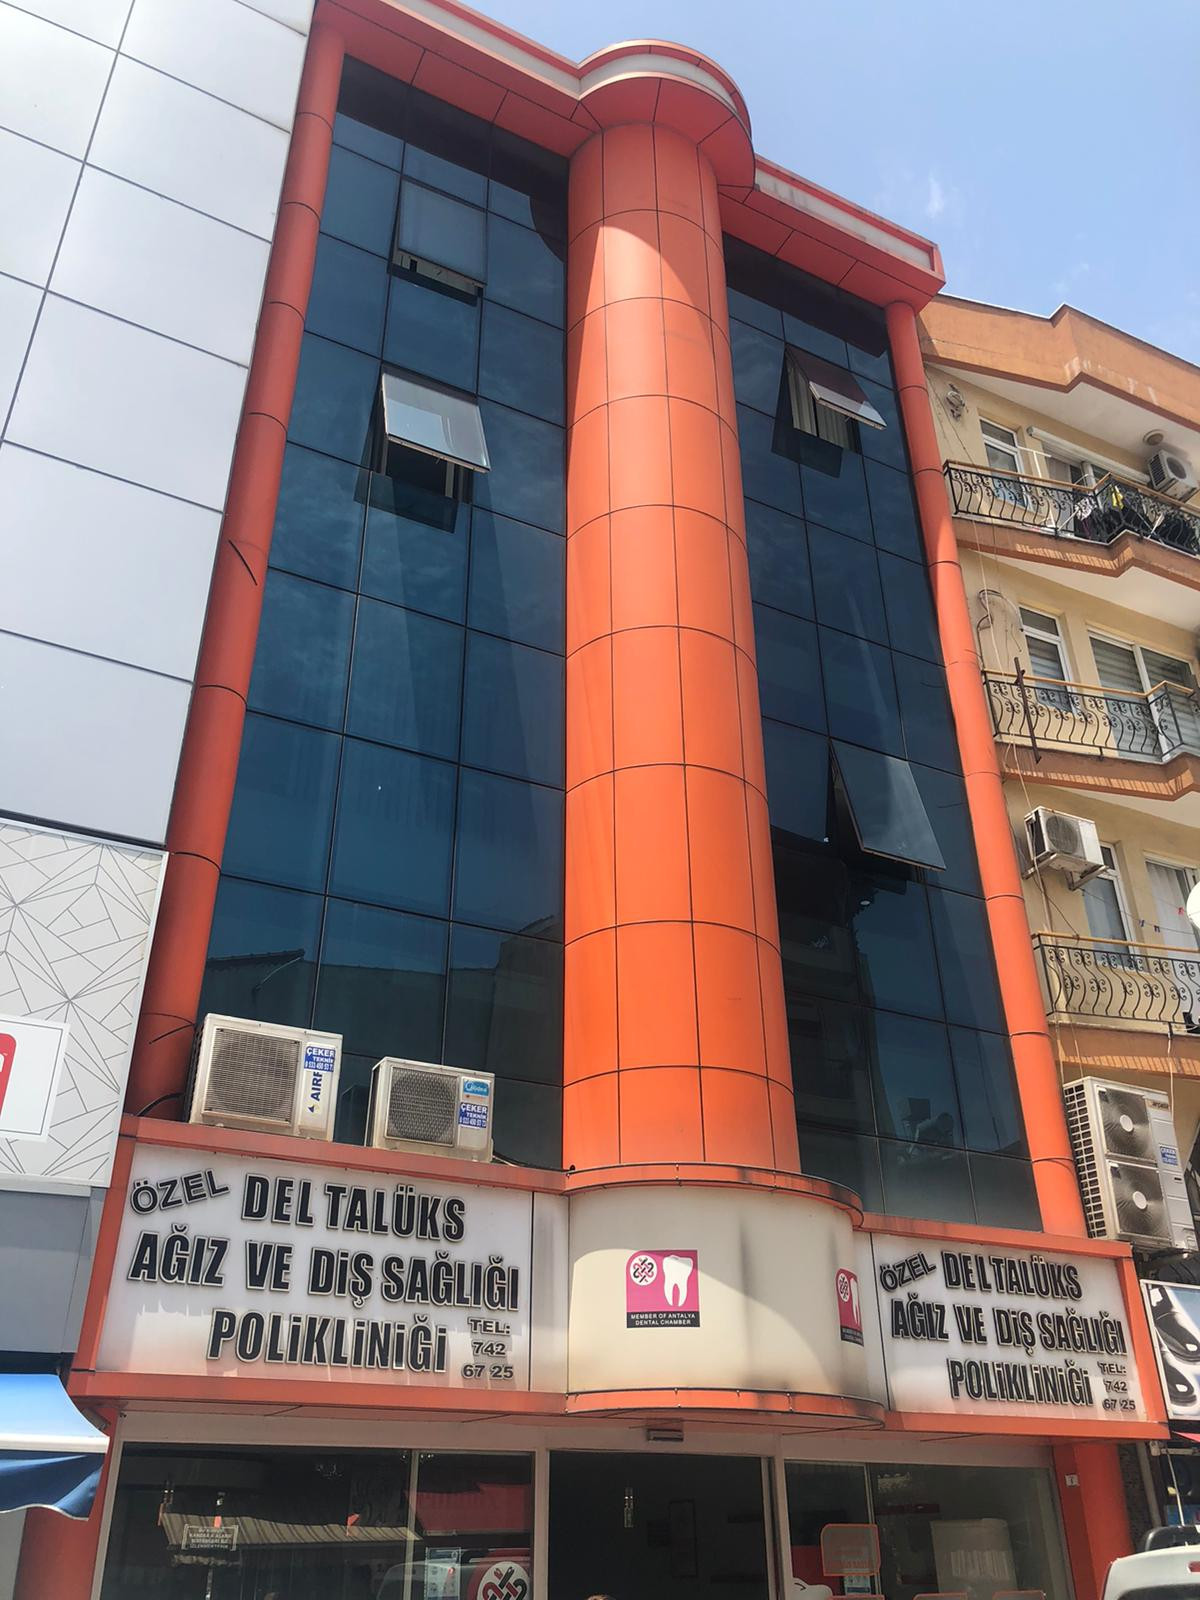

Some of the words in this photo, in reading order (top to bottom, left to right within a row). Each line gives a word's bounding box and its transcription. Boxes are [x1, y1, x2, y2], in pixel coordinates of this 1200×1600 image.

[131, 1168, 229, 1215] ÖZEL
[127, 1223, 230, 1287] AĞIZ
[245, 1239, 293, 1292] VE
[381, 1250, 520, 1311] SAĞLIĞI
[880, 1252, 937, 1292] ÖZEL
[467, 1317, 511, 1335] TEL:
[891, 1292, 950, 1341] AĞIZ
[953, 1304, 987, 1344] VE
[1037, 1307, 1129, 1356] SAĞLIĞI
[472, 1341, 507, 1356] 742
[461, 1364, 484, 1379] 67
[490, 1364, 514, 1380] 25
[1098, 1361, 1127, 1376] TEL:
[1103, 1378, 1127, 1393] 742
[1103, 1398, 1118, 1410] 67
[1120, 1399, 1136, 1411] 25
